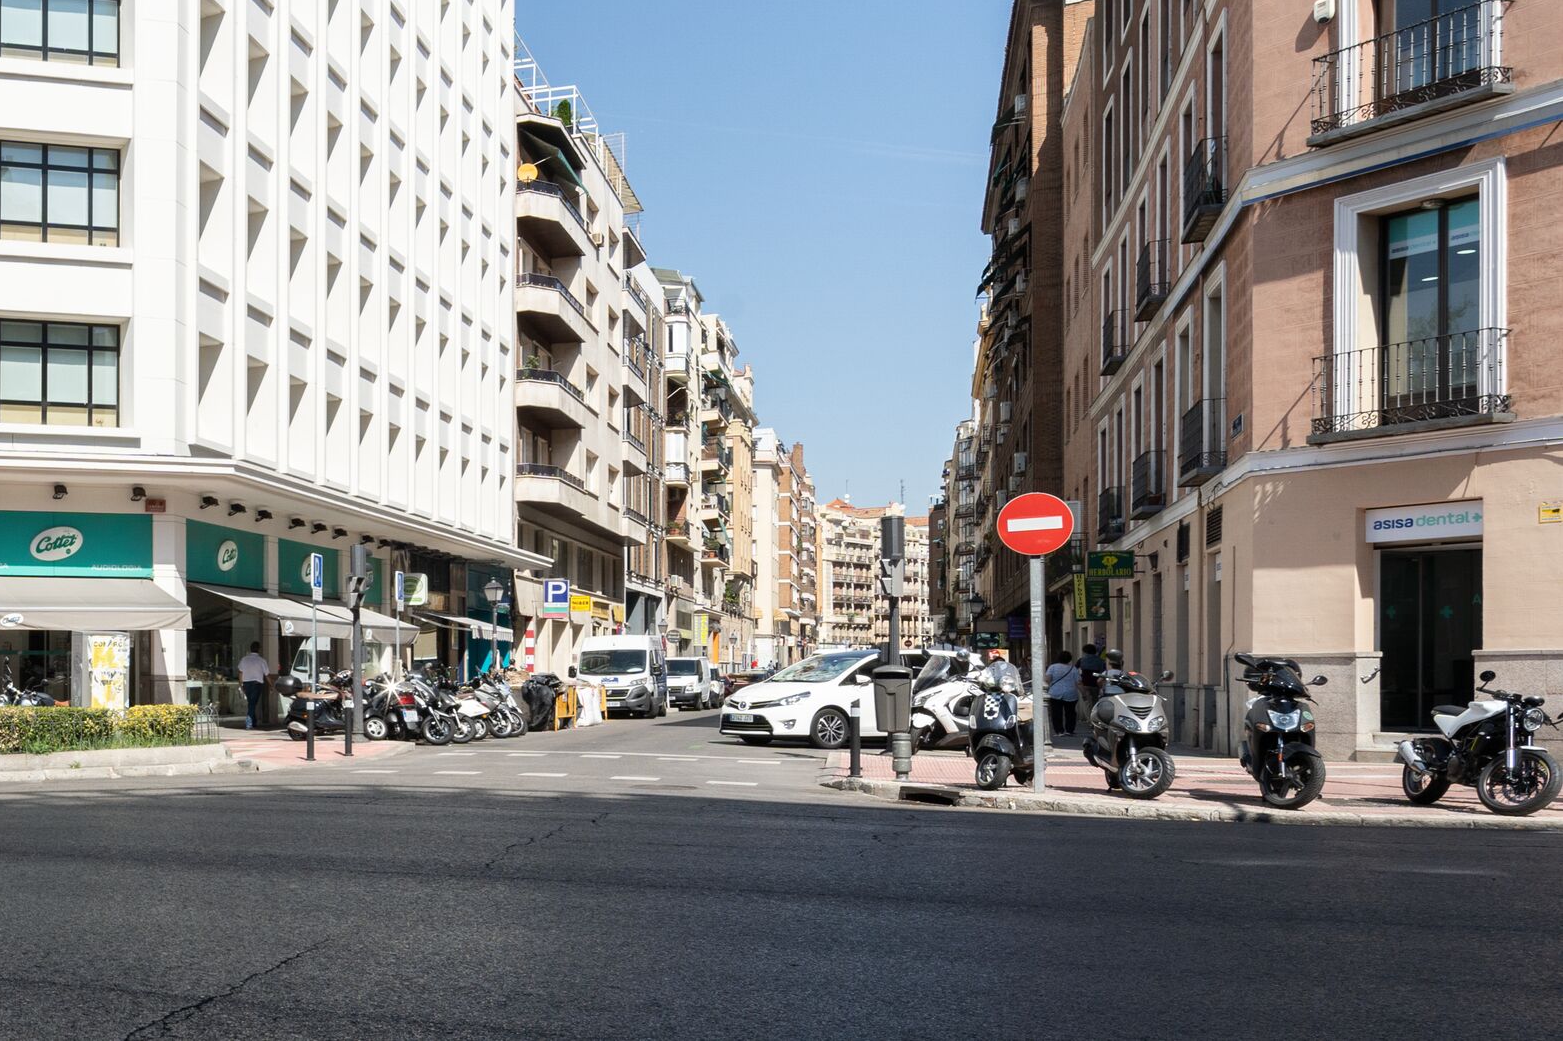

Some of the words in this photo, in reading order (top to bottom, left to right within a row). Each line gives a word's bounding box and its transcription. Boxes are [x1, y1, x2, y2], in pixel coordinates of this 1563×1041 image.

[1373, 518, 1413, 531] asisa
[1416, 511, 1470, 527] dental
[35, 533, 79, 554] Cottet
[1089, 567, 1132, 576] HERBOLARIO
[548, 582, 566, 602] P
